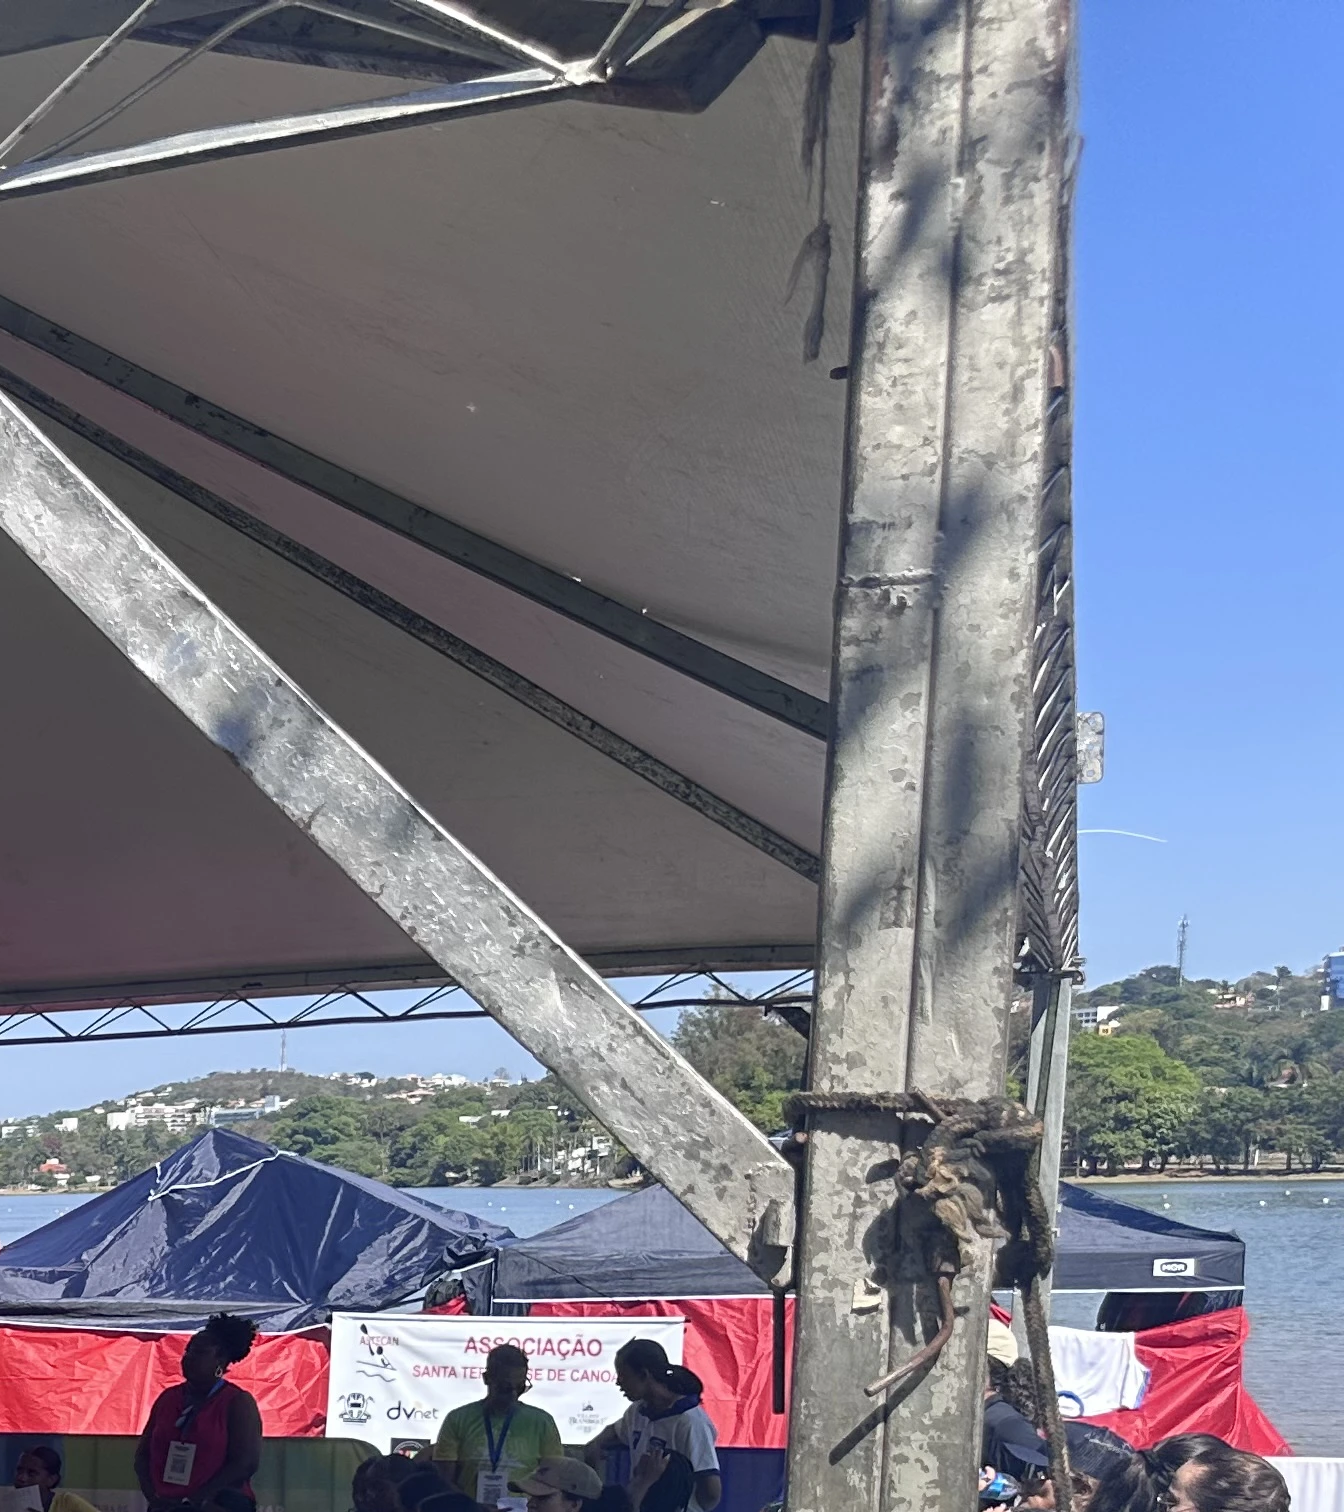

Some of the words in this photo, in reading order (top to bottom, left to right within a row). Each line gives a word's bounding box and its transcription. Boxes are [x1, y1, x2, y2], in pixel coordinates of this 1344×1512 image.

[412, 1365, 457, 1379] SANTA
[548, 1368, 566, 1382] DE
[570, 1370, 617, 1383] CANOA
[387, 1400, 439, 1420] dvnet
